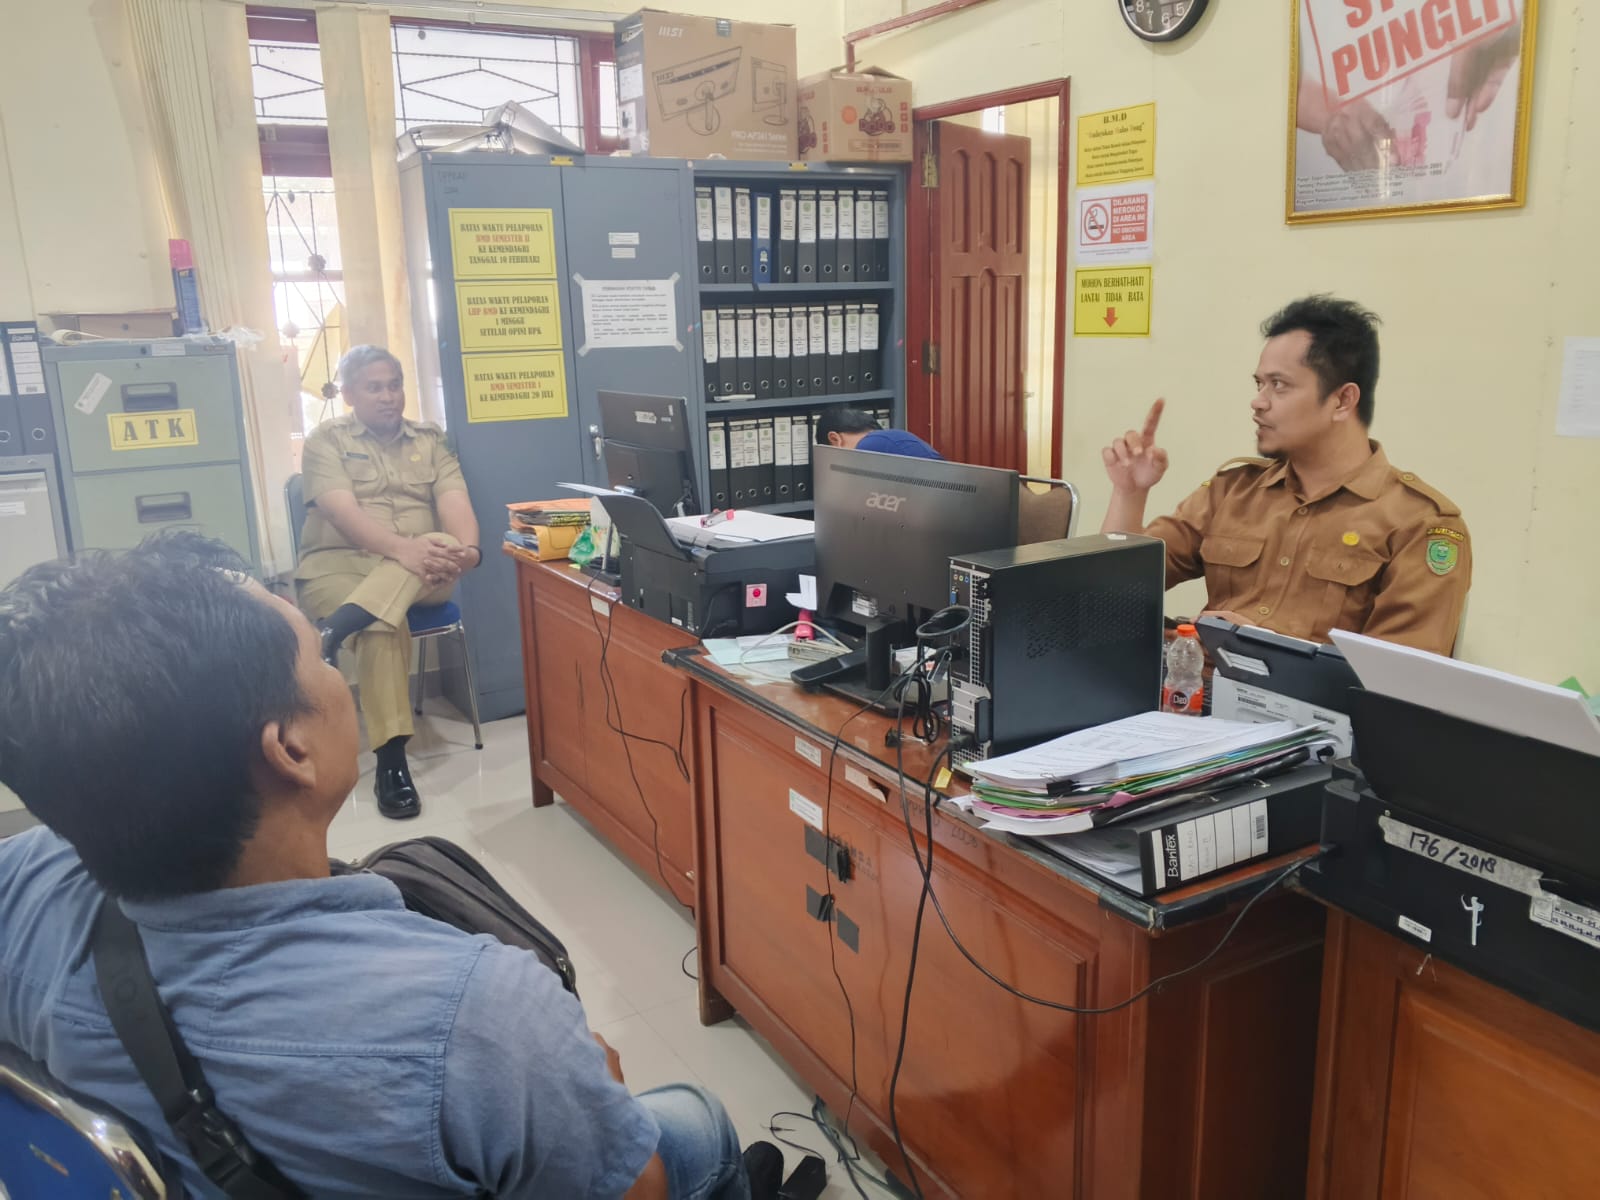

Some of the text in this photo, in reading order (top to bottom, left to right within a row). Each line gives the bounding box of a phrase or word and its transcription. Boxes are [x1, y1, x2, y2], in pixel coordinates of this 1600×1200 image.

[1136, 0, 1144, 13] 8
[1176, 2, 1185, 16] 5
[1146, 10, 1154, 25] 7
[1161, 12, 1170, 25] 6
[1332, 0, 1499, 96] PUNGLI
[1112, 196, 1145, 205] DILARANG
[1113, 204, 1145, 214] MEROKOK
[1120, 213, 1136, 222] AREA
[460, 223, 543, 232] BATAS WAKTU PELAPORAN
[476, 234, 490, 243] BMD
[492, 234, 521, 243] SEMESTER
[1121, 233, 1136, 241] AREA
[478, 245, 530, 254] KE KEMENDAGRI
[469, 255, 540, 264] TANGGAL 10 FEBRUARI
[1081, 276, 1144, 288] MOHON BERHATI-HATI
[467, 295, 549, 305] BATAS WAKTU PELAPORAN
[1081, 291, 1144, 303] LANTAI TIDAK RATA
[483, 307, 498, 316] BMD
[500, 307, 508, 315] KE
[509, 306, 550, 315] KEMENDAGRI
[501, 317, 525, 326] MINGGU
[480, 326, 542, 336] SETELAH OPINI BPK
[474, 370, 555, 381] BATAS WAKTU PELAPORAN
[490, 383, 505, 391] BMD
[507, 381, 536, 390] SEMESTER
[480, 390, 554, 402] KE KEMENDAGRI 20 JULI
[866, 492, 907, 512] acer
[1165, 834, 1179, 877] Bantex
